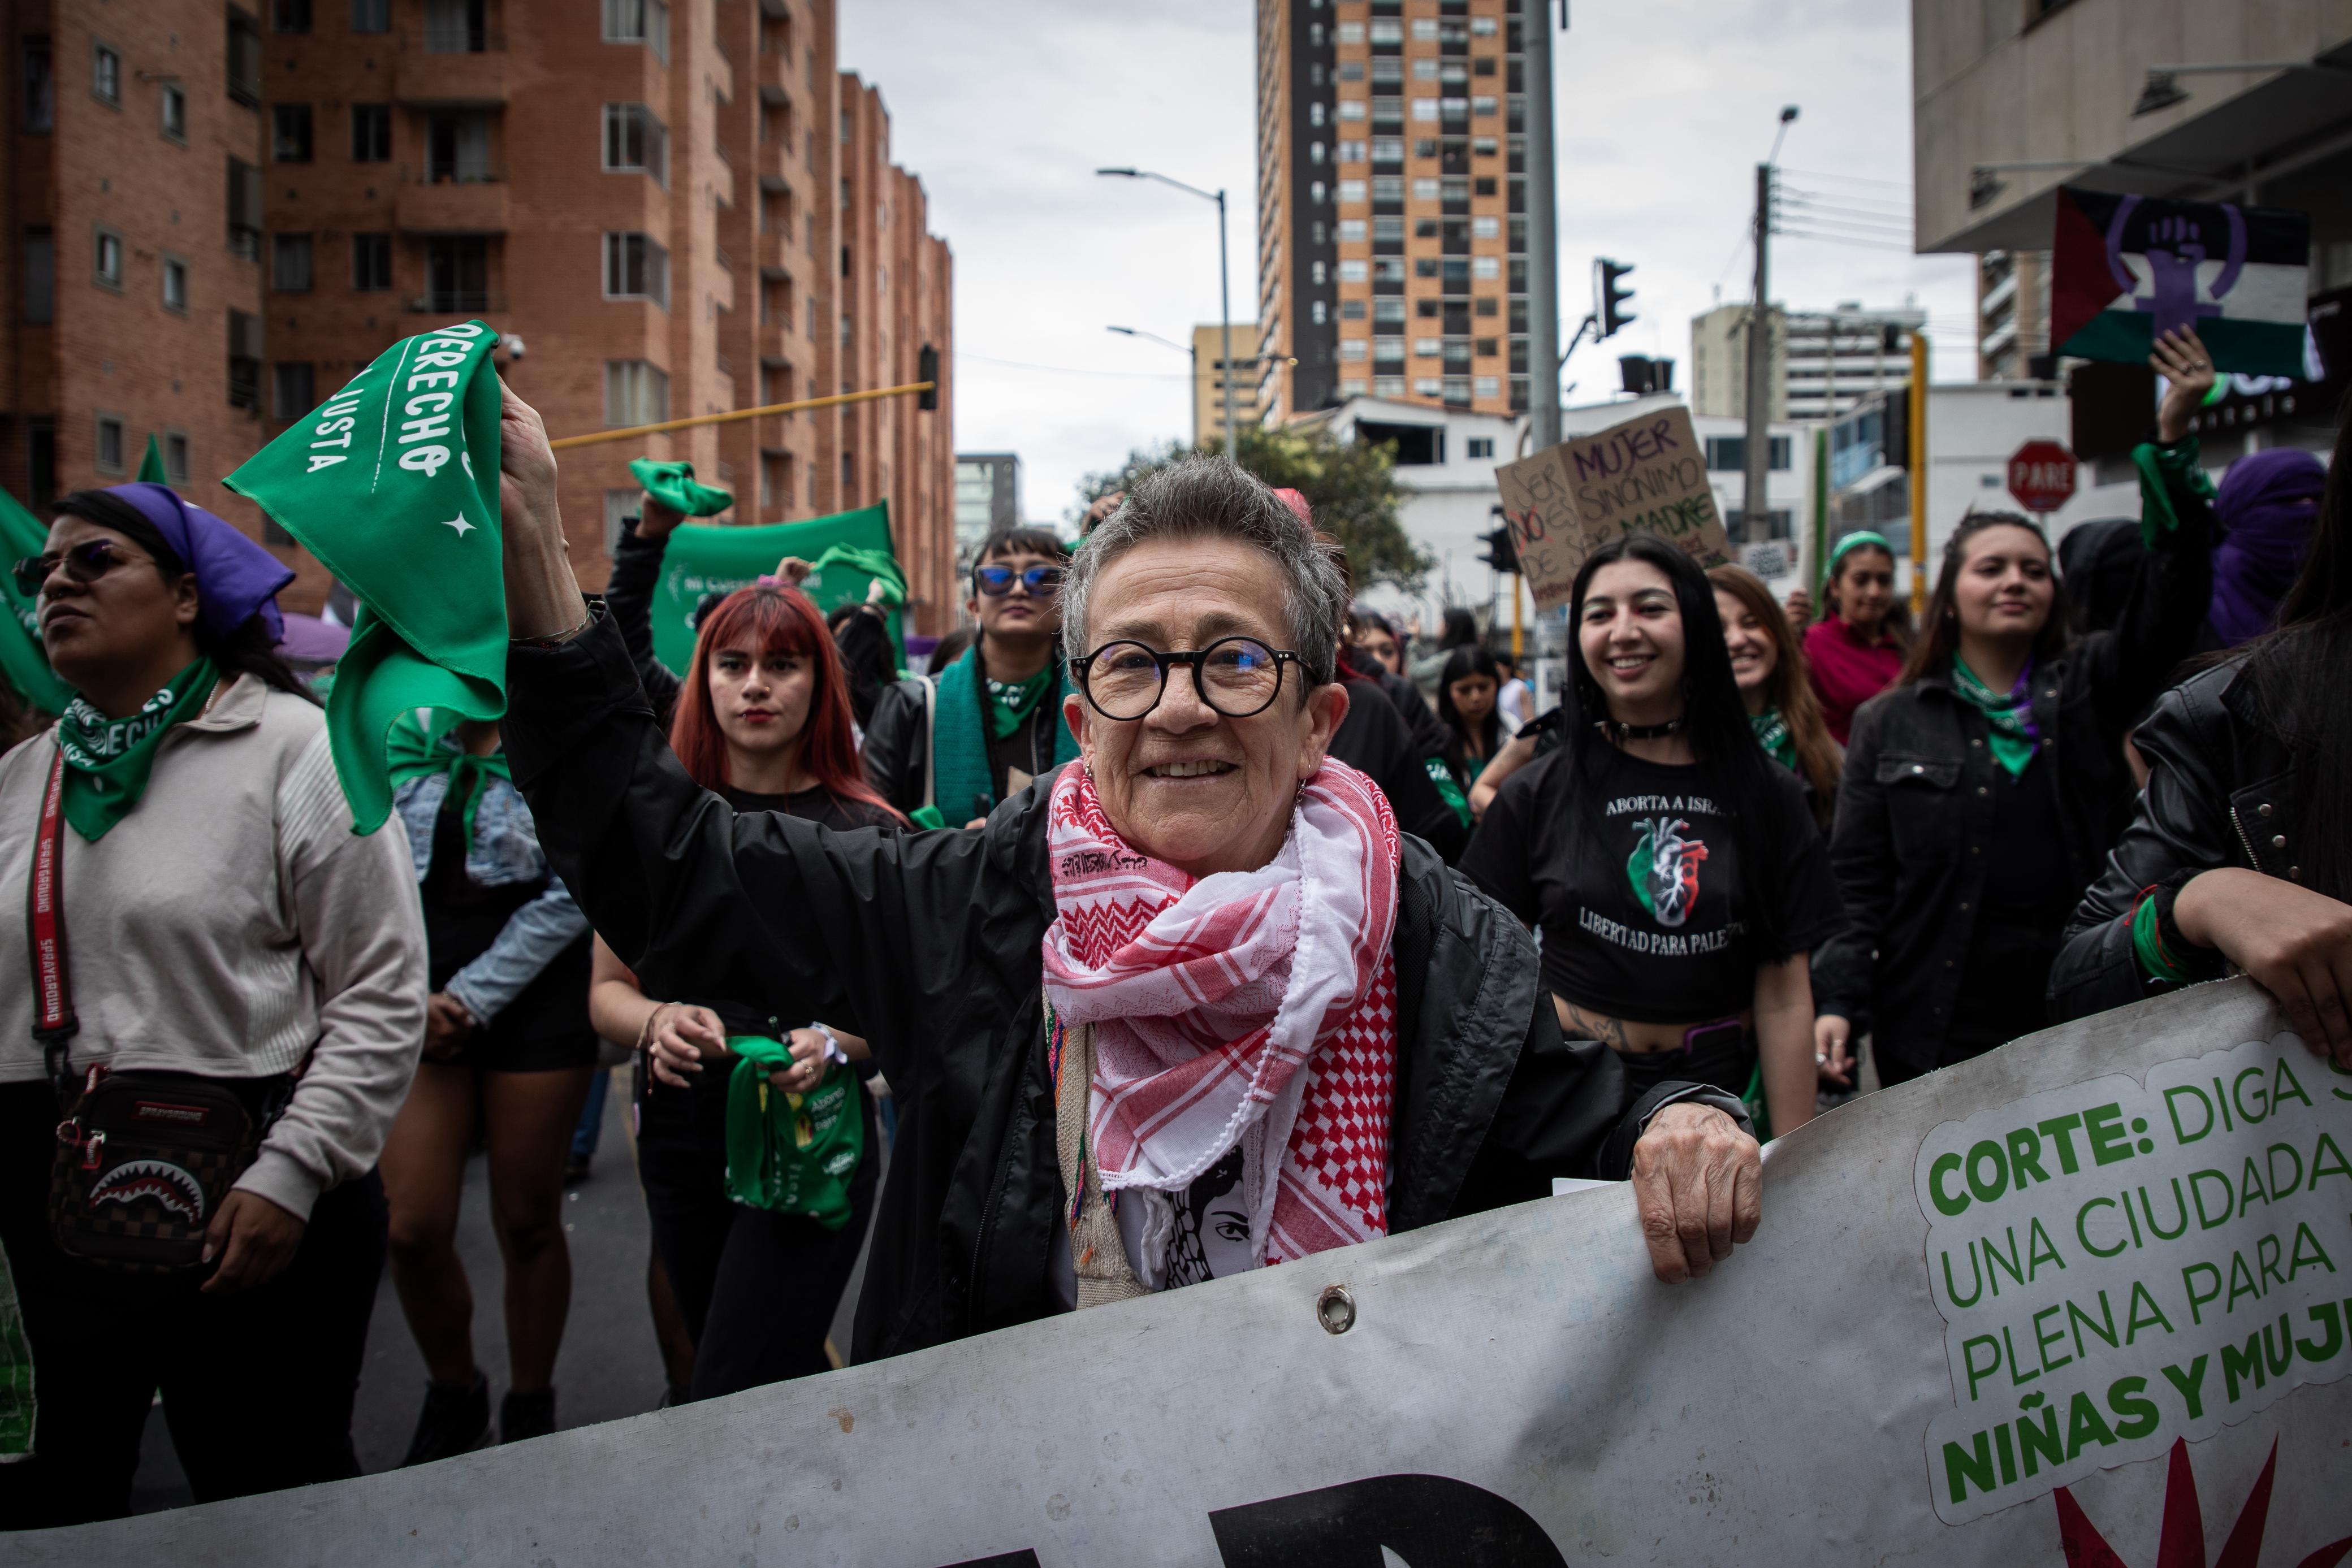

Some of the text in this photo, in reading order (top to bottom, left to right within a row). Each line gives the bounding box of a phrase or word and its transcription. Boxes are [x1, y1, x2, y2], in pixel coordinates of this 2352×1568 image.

[306, 389, 365, 473] JUSTA
[398, 324, 484, 477] DERECHO
[1511, 419, 1679, 508] SER MUJER
[2013, 461, 2072, 490] PARE
[1523, 549, 1559, 581] DE
[1619, 493, 1714, 535] MADRE
[1546, 497, 1576, 530] ES
[1606, 795, 1670, 817] ABORTA
[1672, 795, 1684, 811] A
[37, 838, 54, 913] SPRAYGROUND
[1578, 906, 1649, 952] LIBERTAD
[1650, 933, 1689, 956] PARA
[40, 938, 59, 1023] SPRAYGROUND
[1929, 1102, 2154, 1216] CORTE:
[2162, 1058, 2313, 1144] DIGA
[1941, 1216, 2066, 1309] UNA
[1962, 1222, 2336, 1402] PLENA PARA
[1942, 1298, 2352, 1504] NIÑAS Y MUJ
